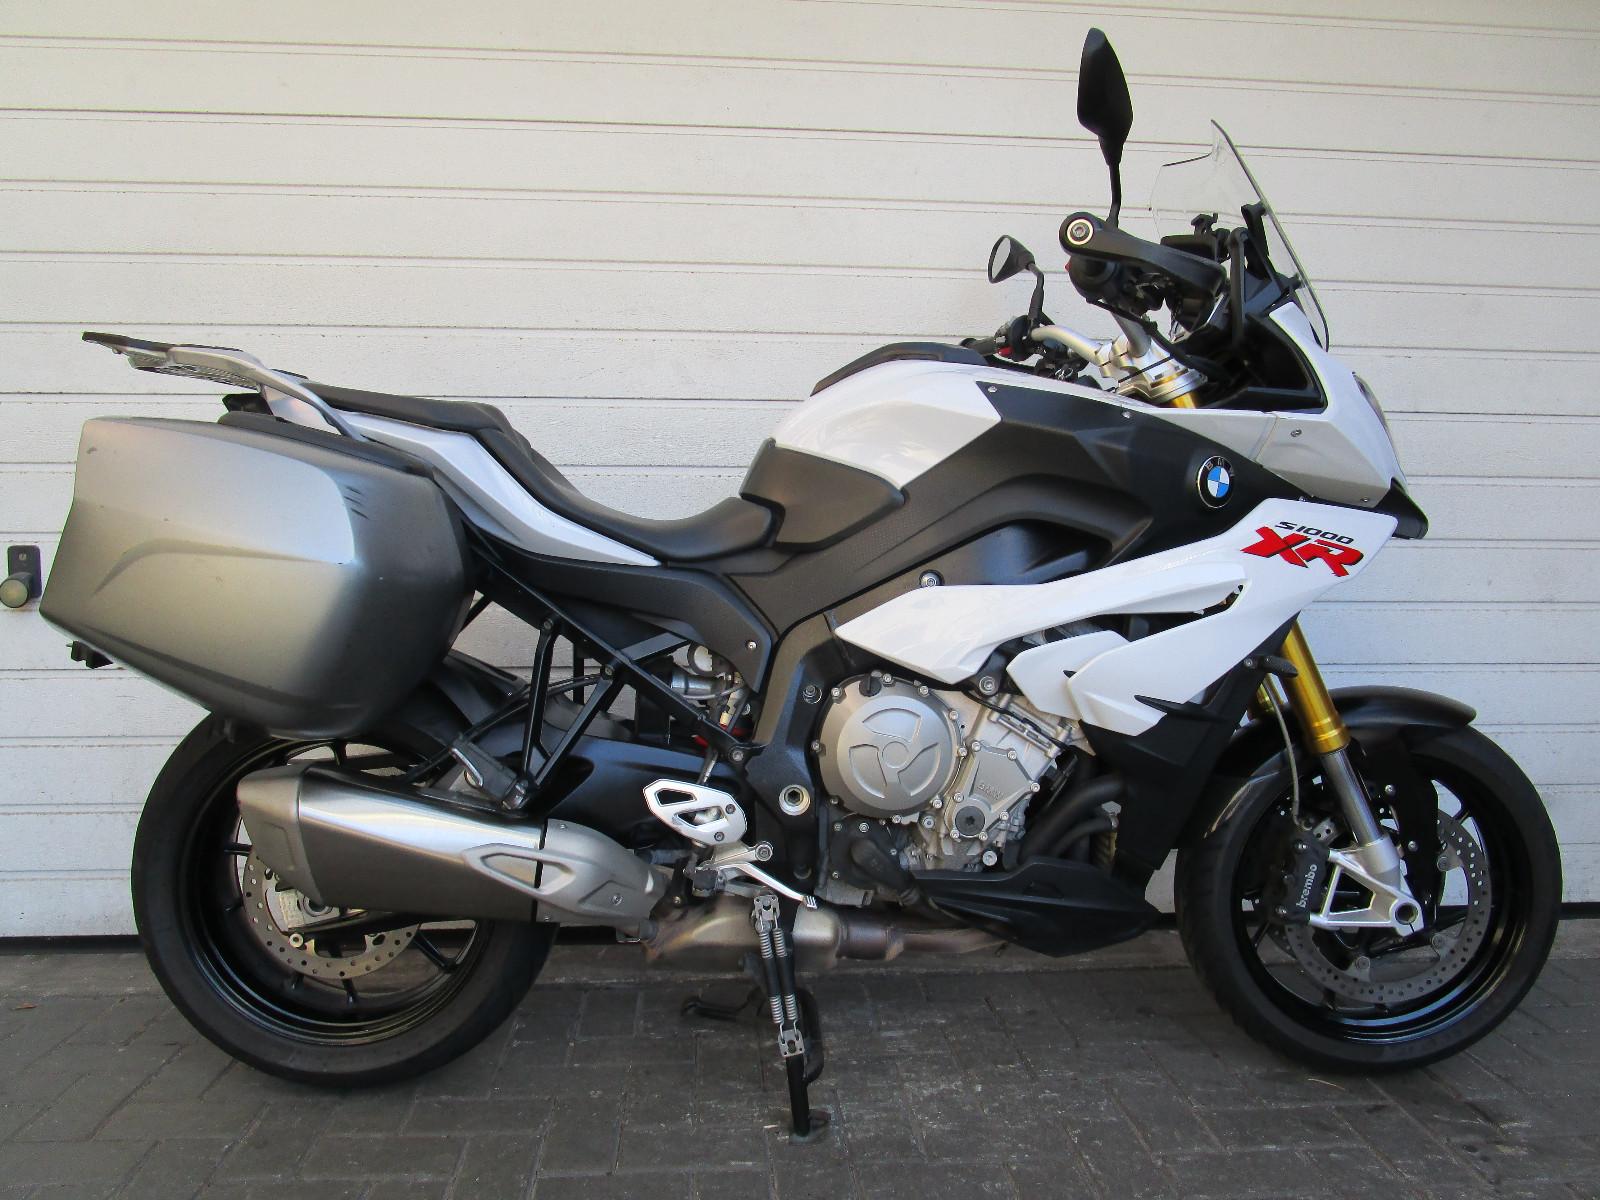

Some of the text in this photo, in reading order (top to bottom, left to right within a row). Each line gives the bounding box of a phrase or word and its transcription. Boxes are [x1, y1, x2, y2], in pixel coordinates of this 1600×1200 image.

[1204, 457, 1235, 477] BMW
[1275, 521, 1354, 545] S1000
[1240, 526, 1364, 577] XR
[1296, 864, 1318, 908] brembo
